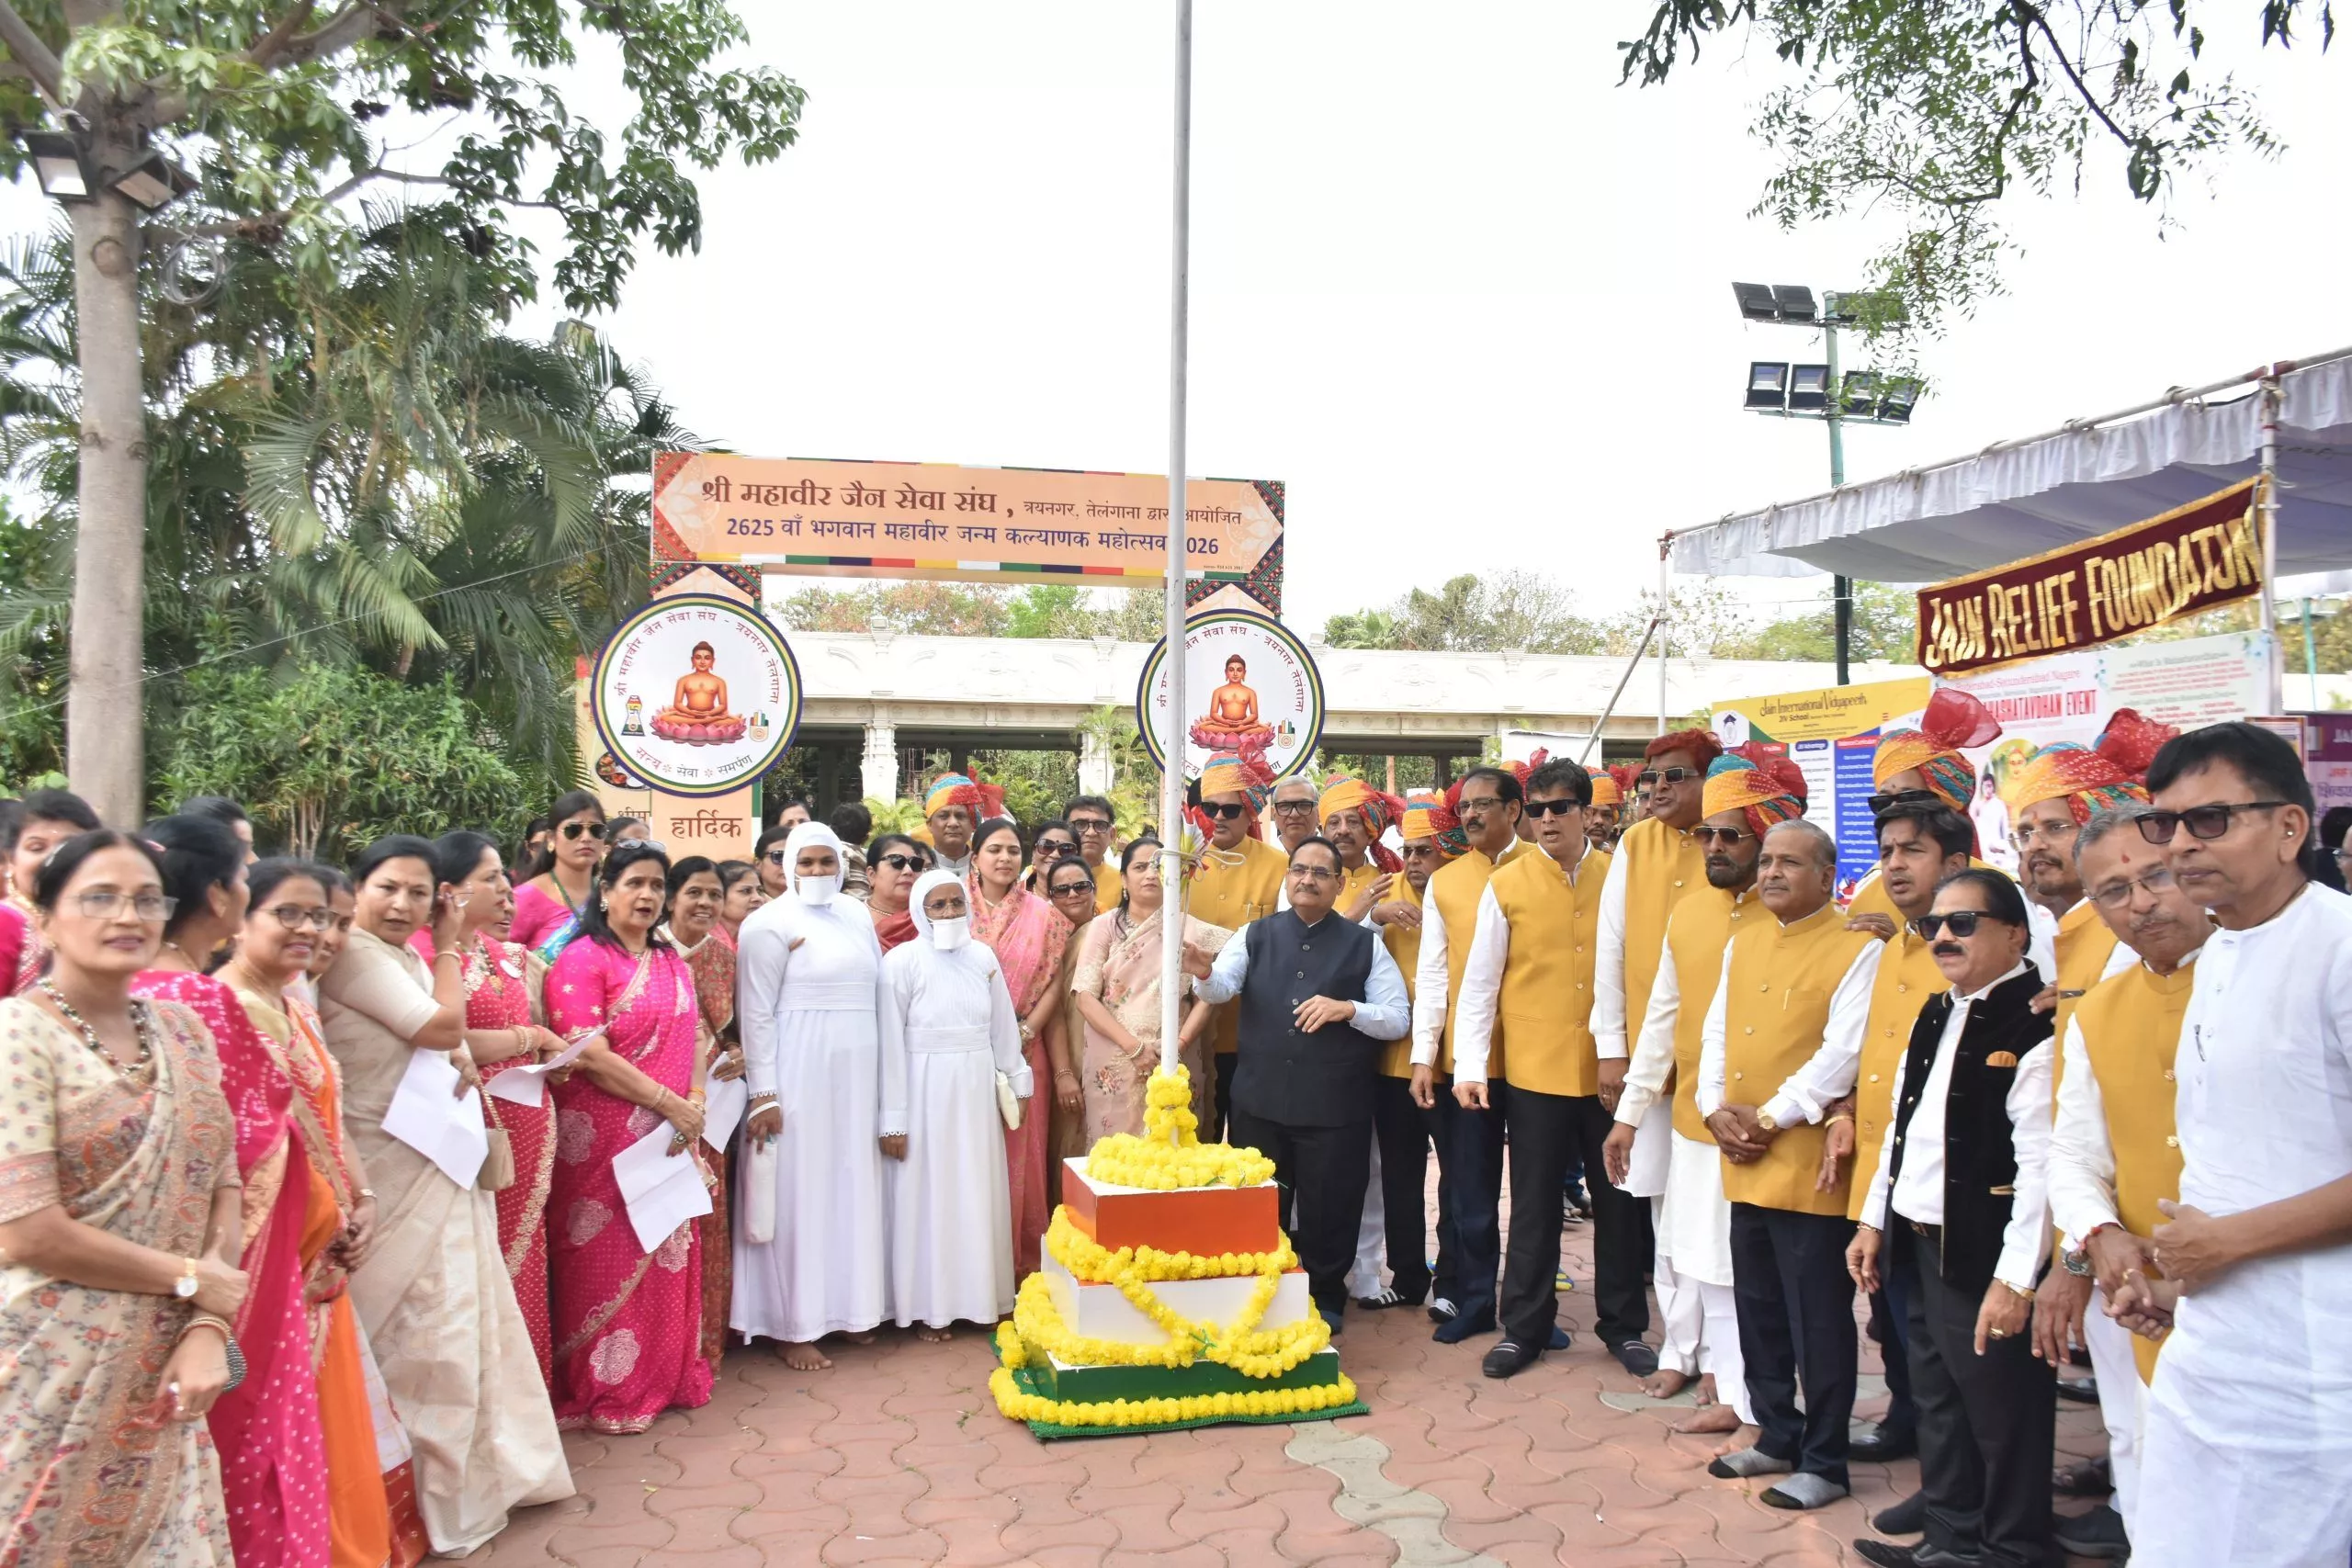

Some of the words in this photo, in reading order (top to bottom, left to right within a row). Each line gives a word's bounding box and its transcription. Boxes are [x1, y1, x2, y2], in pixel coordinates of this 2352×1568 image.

[702, 475, 732, 503] श्री
[741, 479, 832, 506] महावीर
[841, 480, 886, 508] जैन
[895, 482, 945, 512] सेवा
[1086, 499, 1141, 520] तेलंगाना
[1147, 507, 1169, 521] द्वार
[727, 518, 774, 536] 2625
[810, 520, 876, 539] भगवान
[885, 519, 949, 543] महावीर
[957, 526, 997, 545] जन्म
[1005, 528, 1091, 547] कल्याणक
[1098, 526, 1168, 551] महोत्सव
[1186, 536, 1219, 555] 026
[642, 621, 663, 636] जैन
[666, 612, 691, 624] सेवा
[697, 607, 718, 621] संघ
[1925, 597, 1986, 668] JAIN
[1986, 570, 2078, 659] RELIEF
[736, 622, 769, 655] त्रयनगर
[619, 637, 643, 675] महावीर
[1202, 626, 1224, 639] सेवा
[1229, 623, 1248, 636] संघ
[1264, 636, 1294, 667] त्रयनगर
[1291, 669, 1306, 713] तेलंगाना
[614, 682, 628, 696] श्री
[2066, 690, 2097, 716] EVENT
[636, 746, 662, 770] सत्य
[676, 764, 698, 778] सेवा
[718, 754, 752, 774] समर्पण
[670, 808, 743, 839] हार्दिक
